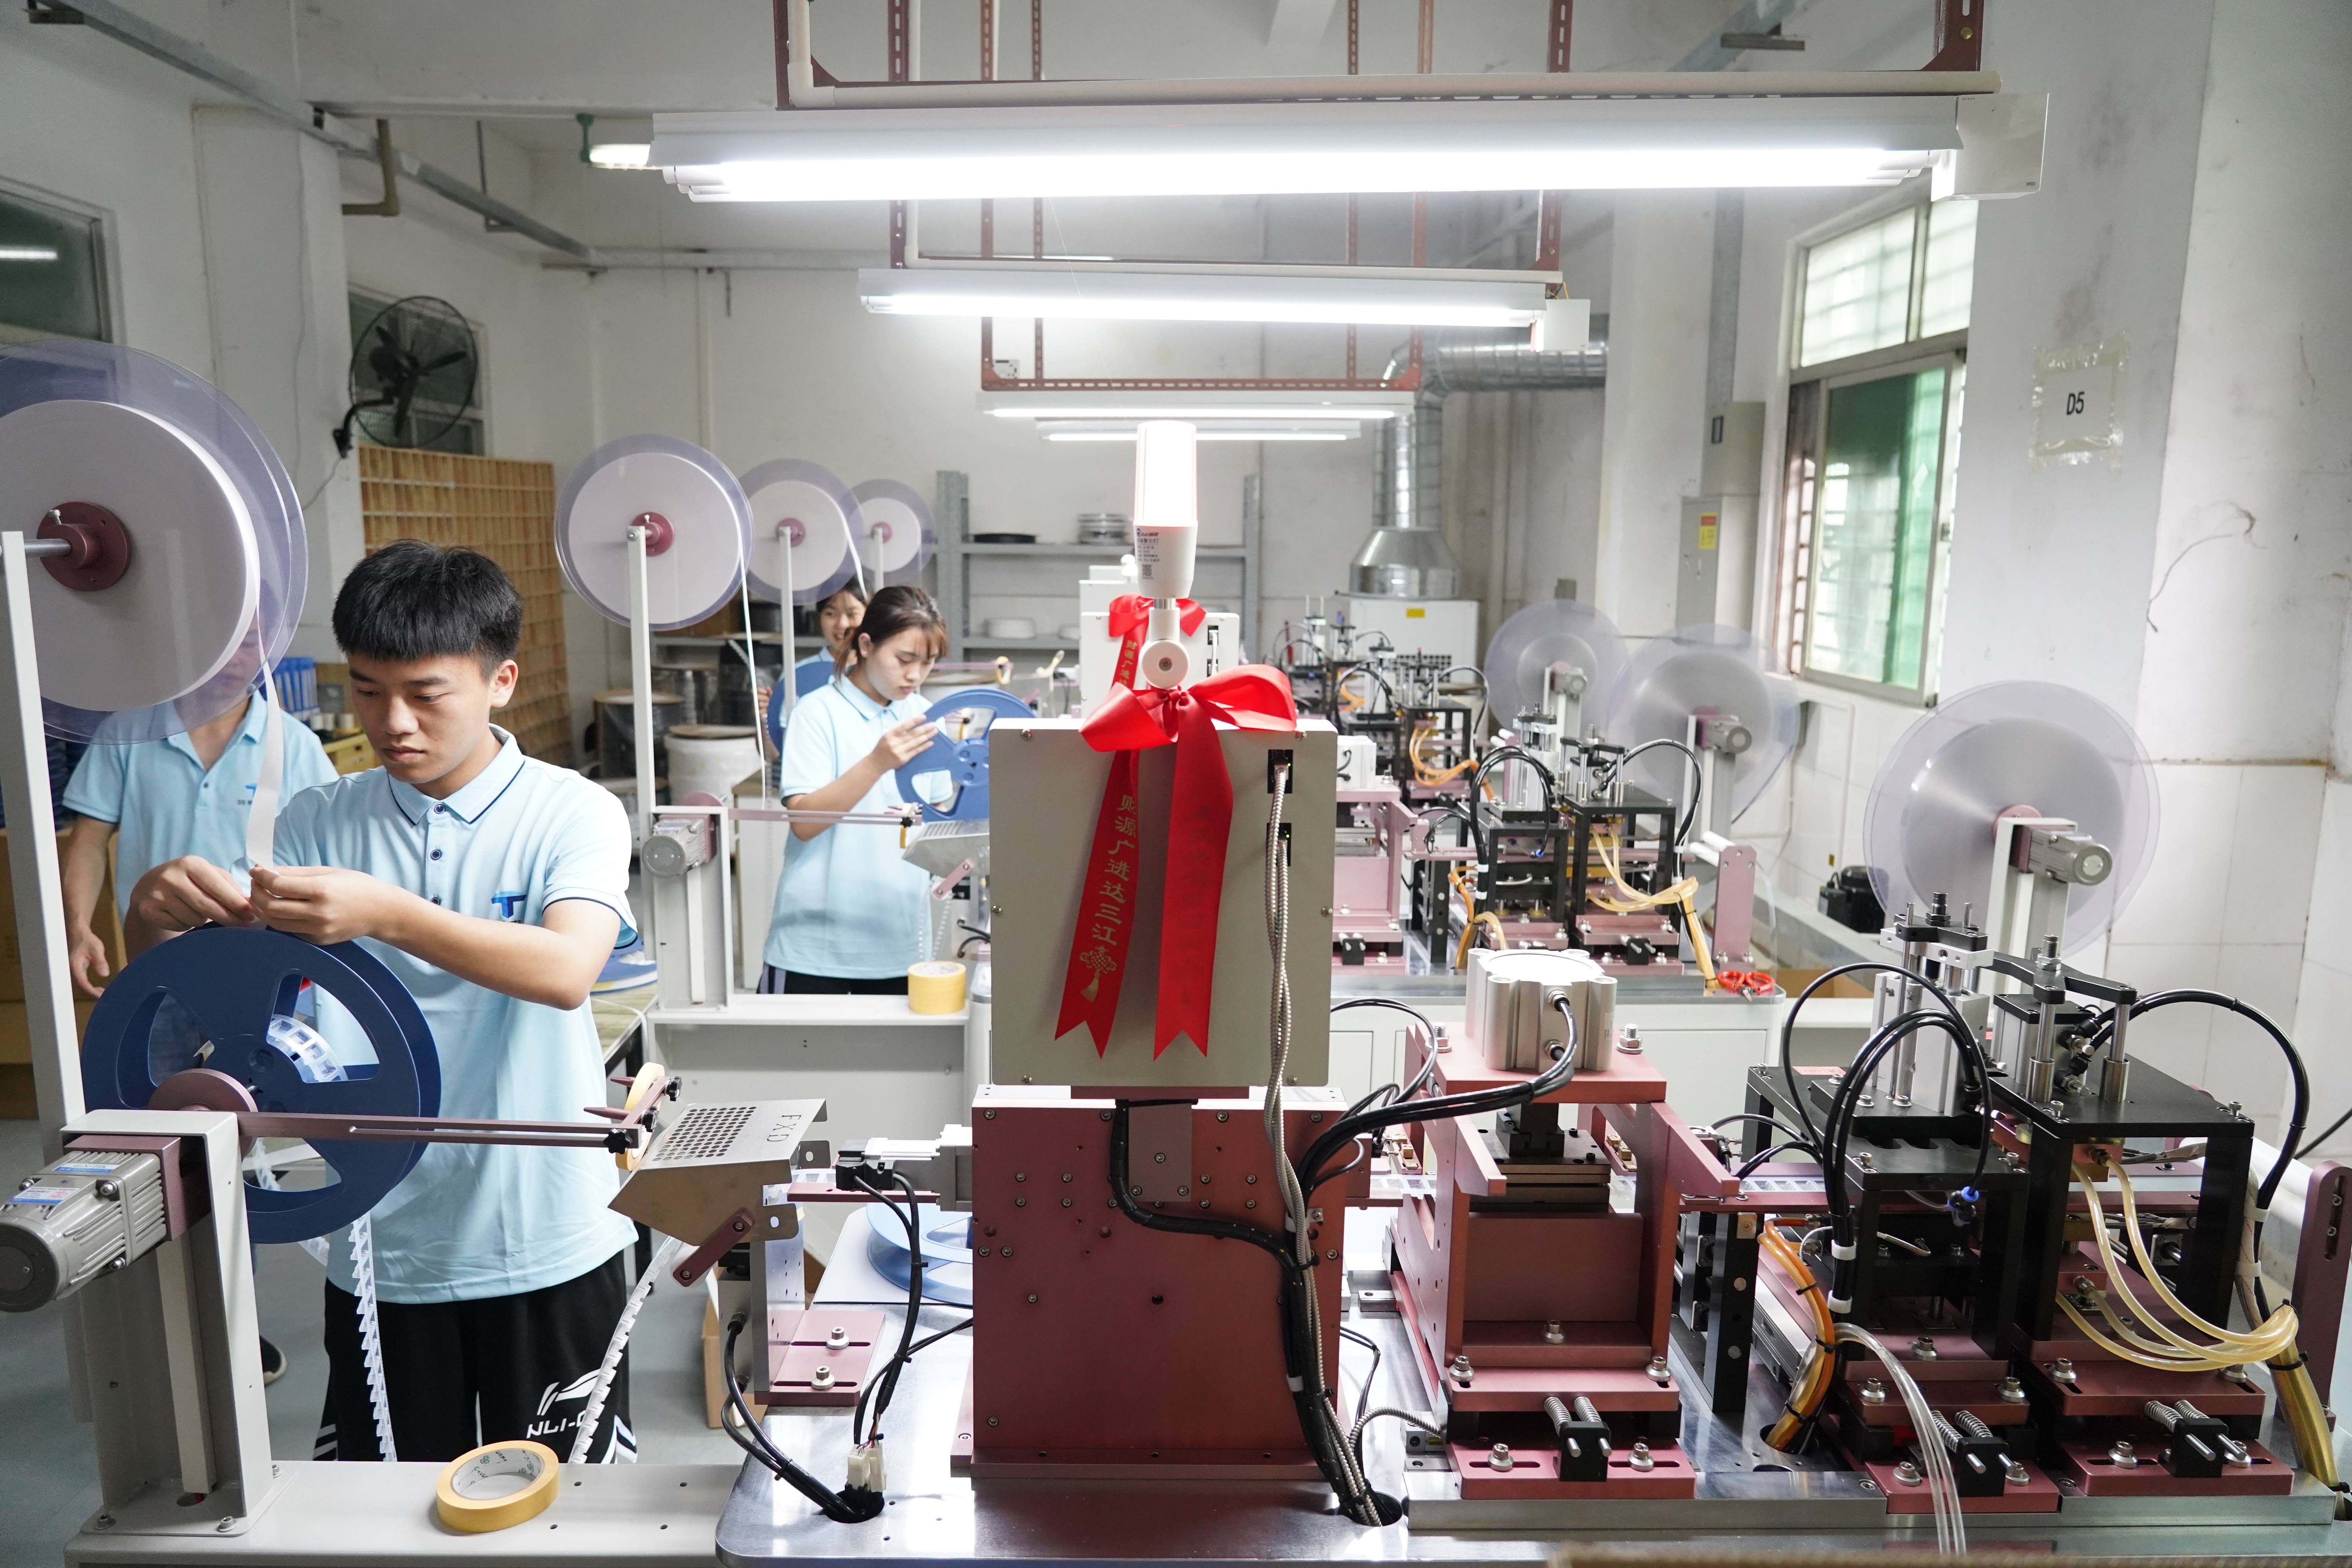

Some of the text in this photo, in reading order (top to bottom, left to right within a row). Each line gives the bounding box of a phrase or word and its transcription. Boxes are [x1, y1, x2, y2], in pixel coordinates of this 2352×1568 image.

[2067, 391, 2085, 415] D5
[1092, 795, 1137, 946] 财源广进达三江
[767, 1114, 802, 1142] FXD
